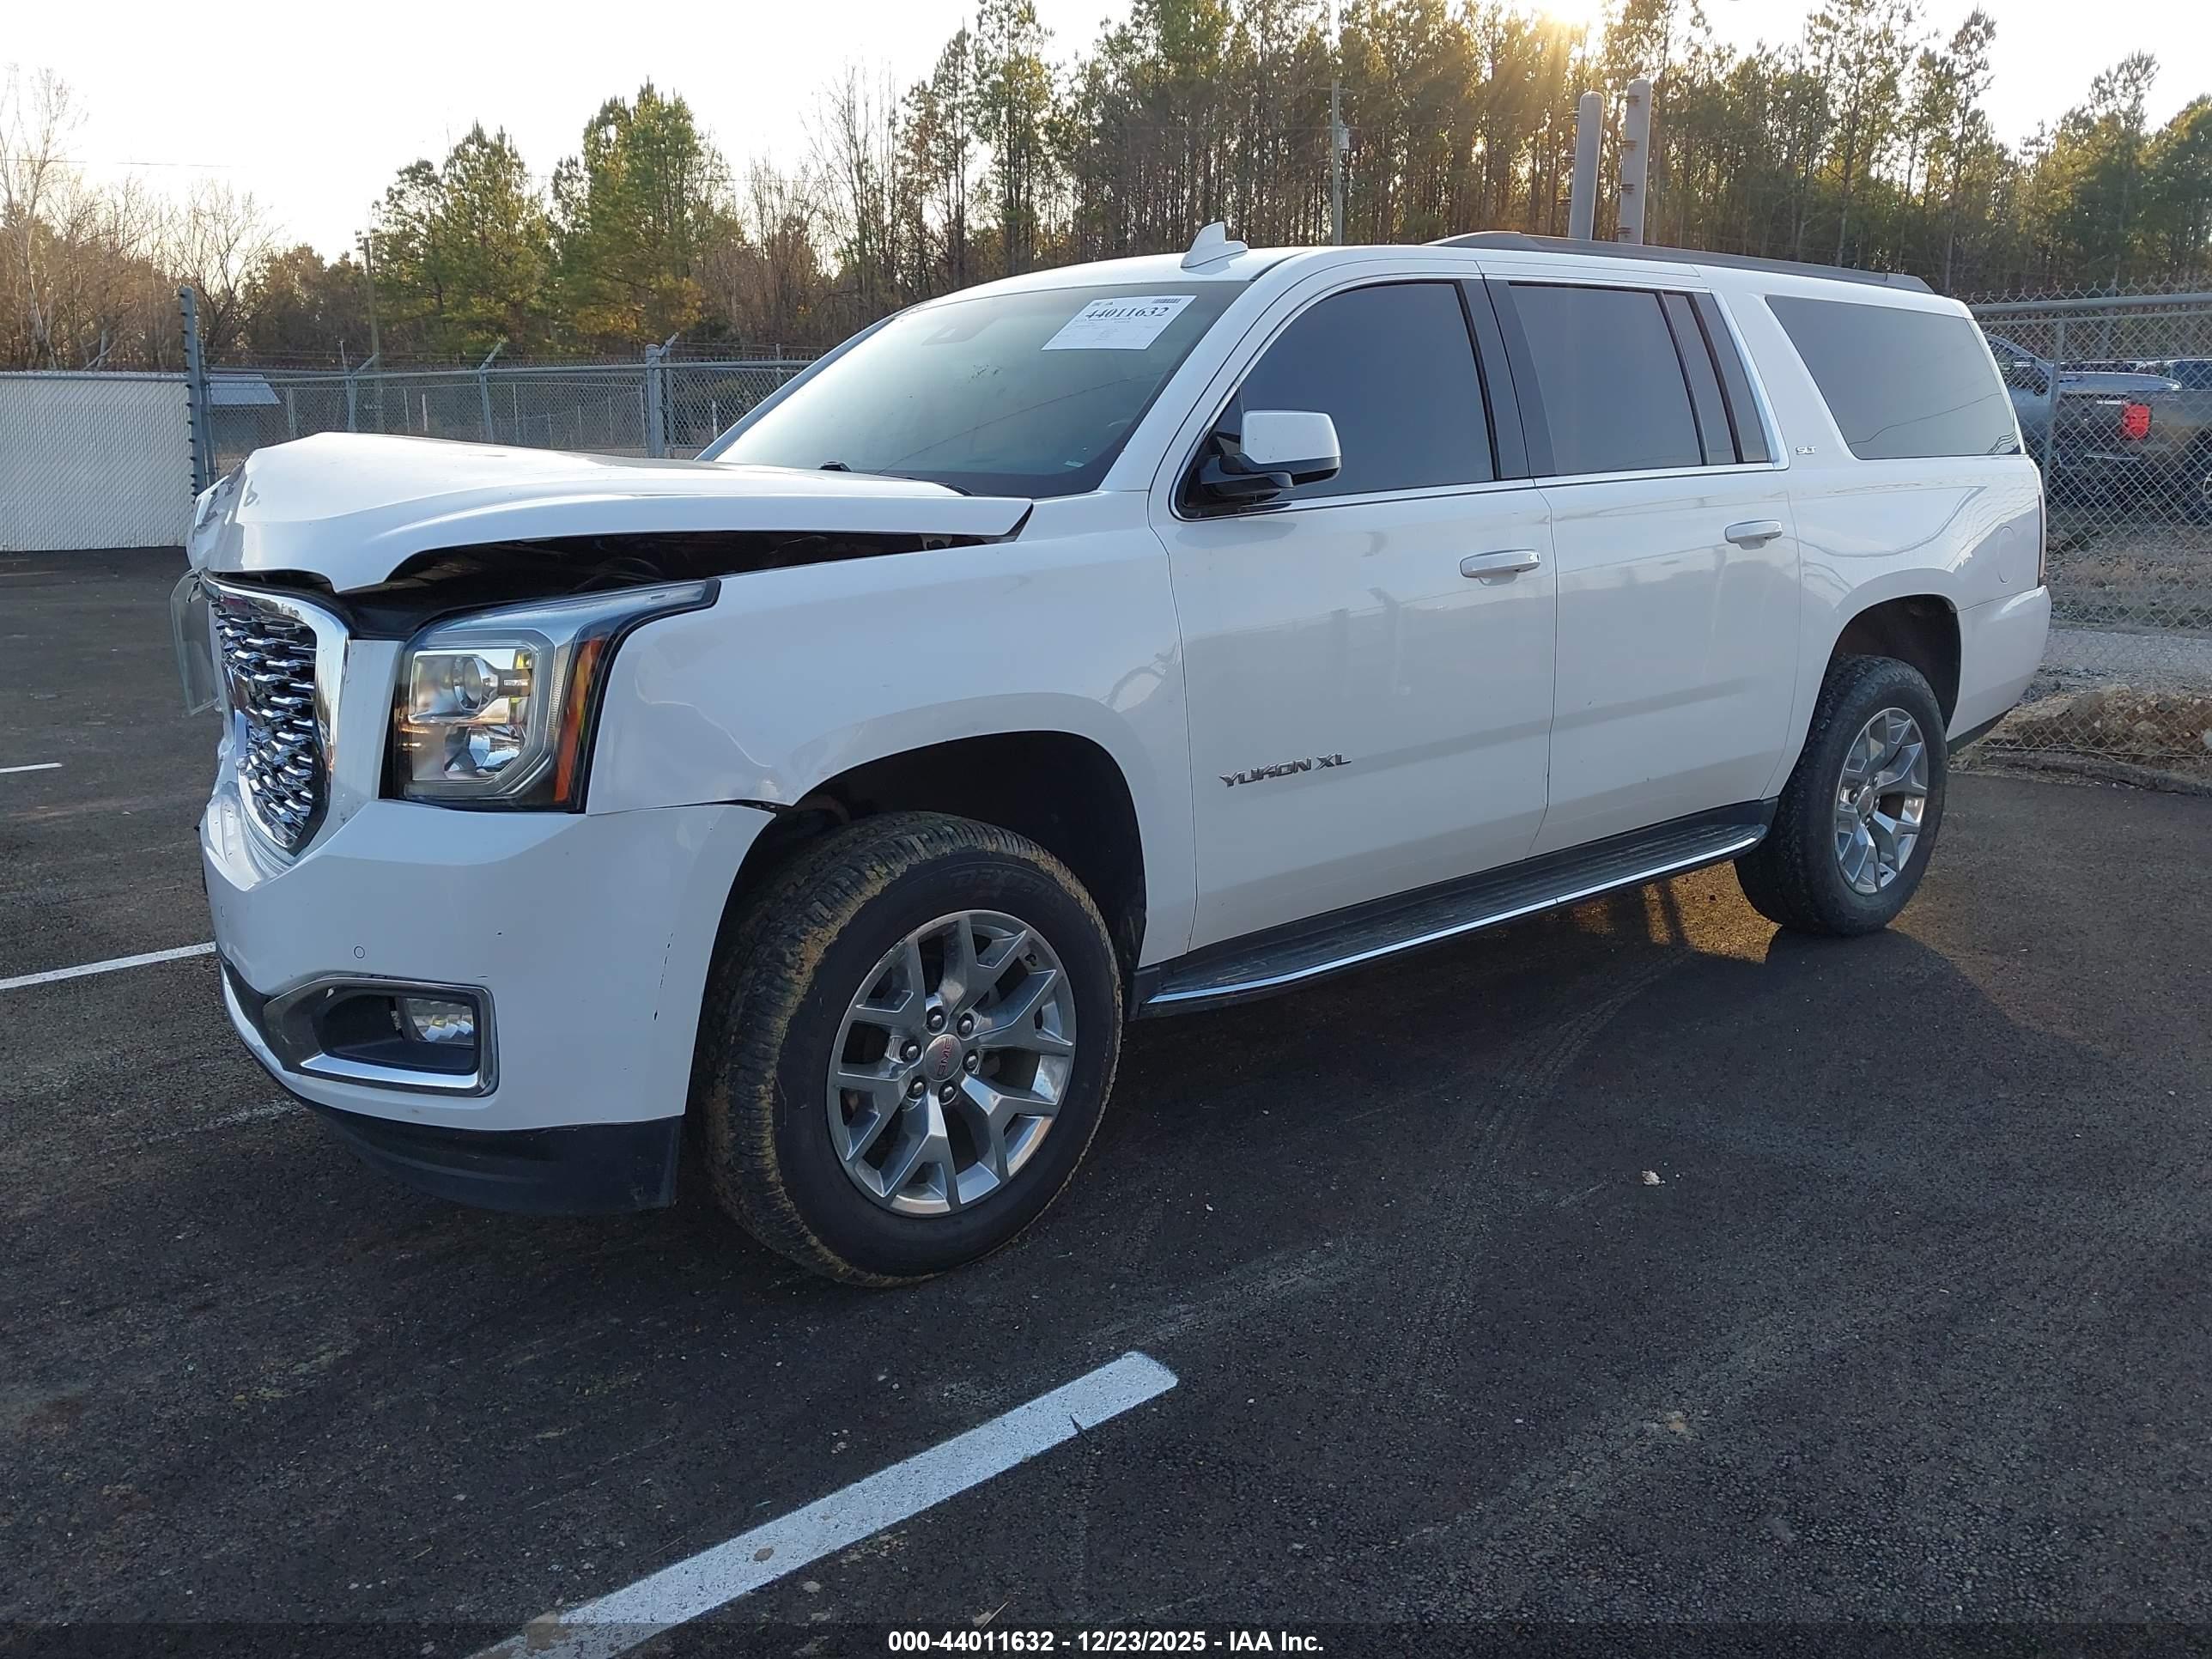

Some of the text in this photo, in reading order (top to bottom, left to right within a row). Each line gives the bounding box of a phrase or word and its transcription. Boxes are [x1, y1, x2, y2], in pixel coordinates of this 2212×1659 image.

[1085, 307, 1170, 319] 44011632
[1796, 446, 1815, 455] SLT
[1219, 753, 1352, 787] YUKON XL
